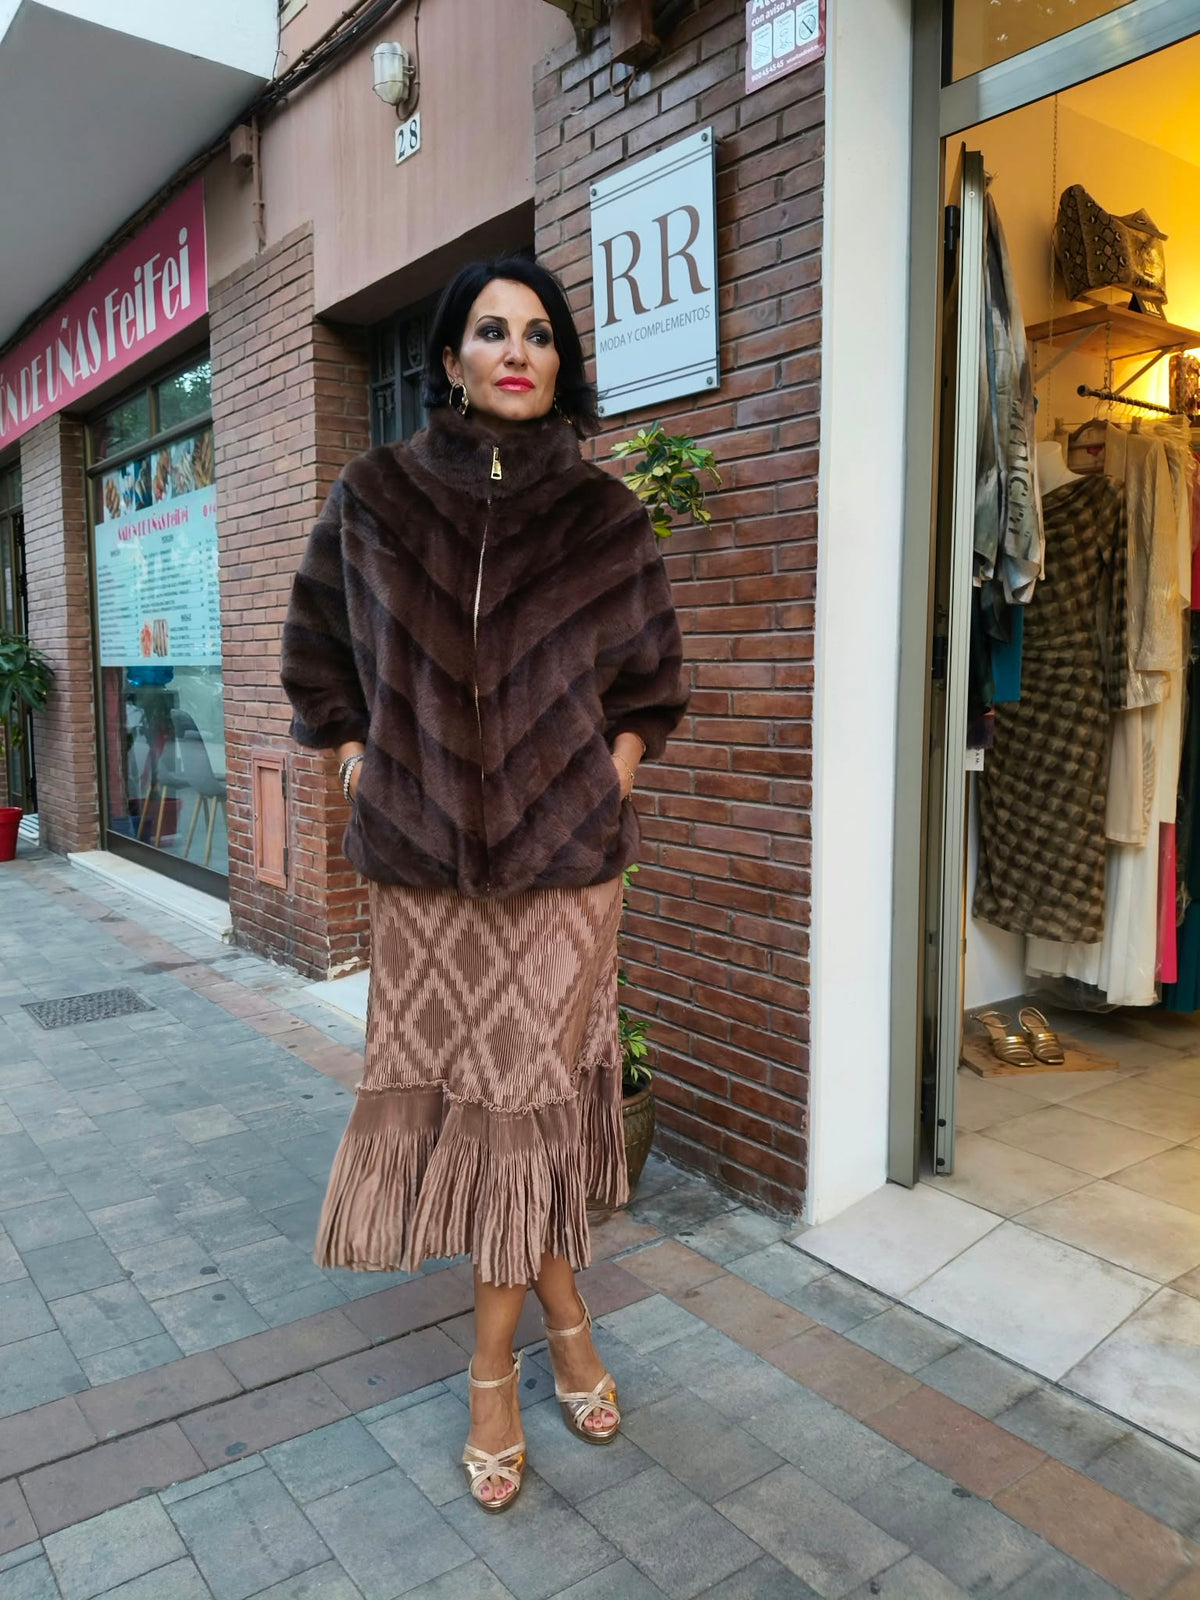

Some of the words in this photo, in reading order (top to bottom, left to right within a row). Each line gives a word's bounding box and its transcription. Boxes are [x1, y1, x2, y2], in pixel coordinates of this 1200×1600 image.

[751, 14, 765, 26] con
[765, 2, 785, 19] aviso
[398, 119, 418, 160] 28
[598, 205, 711, 328] RR
[46, 306, 102, 403] UÑAS
[104, 227, 192, 362] FeiFei
[599, 330, 626, 354] MODA
[627, 328, 633, 344] Y
[634, 305, 711, 342] COMPLEMENTOS
